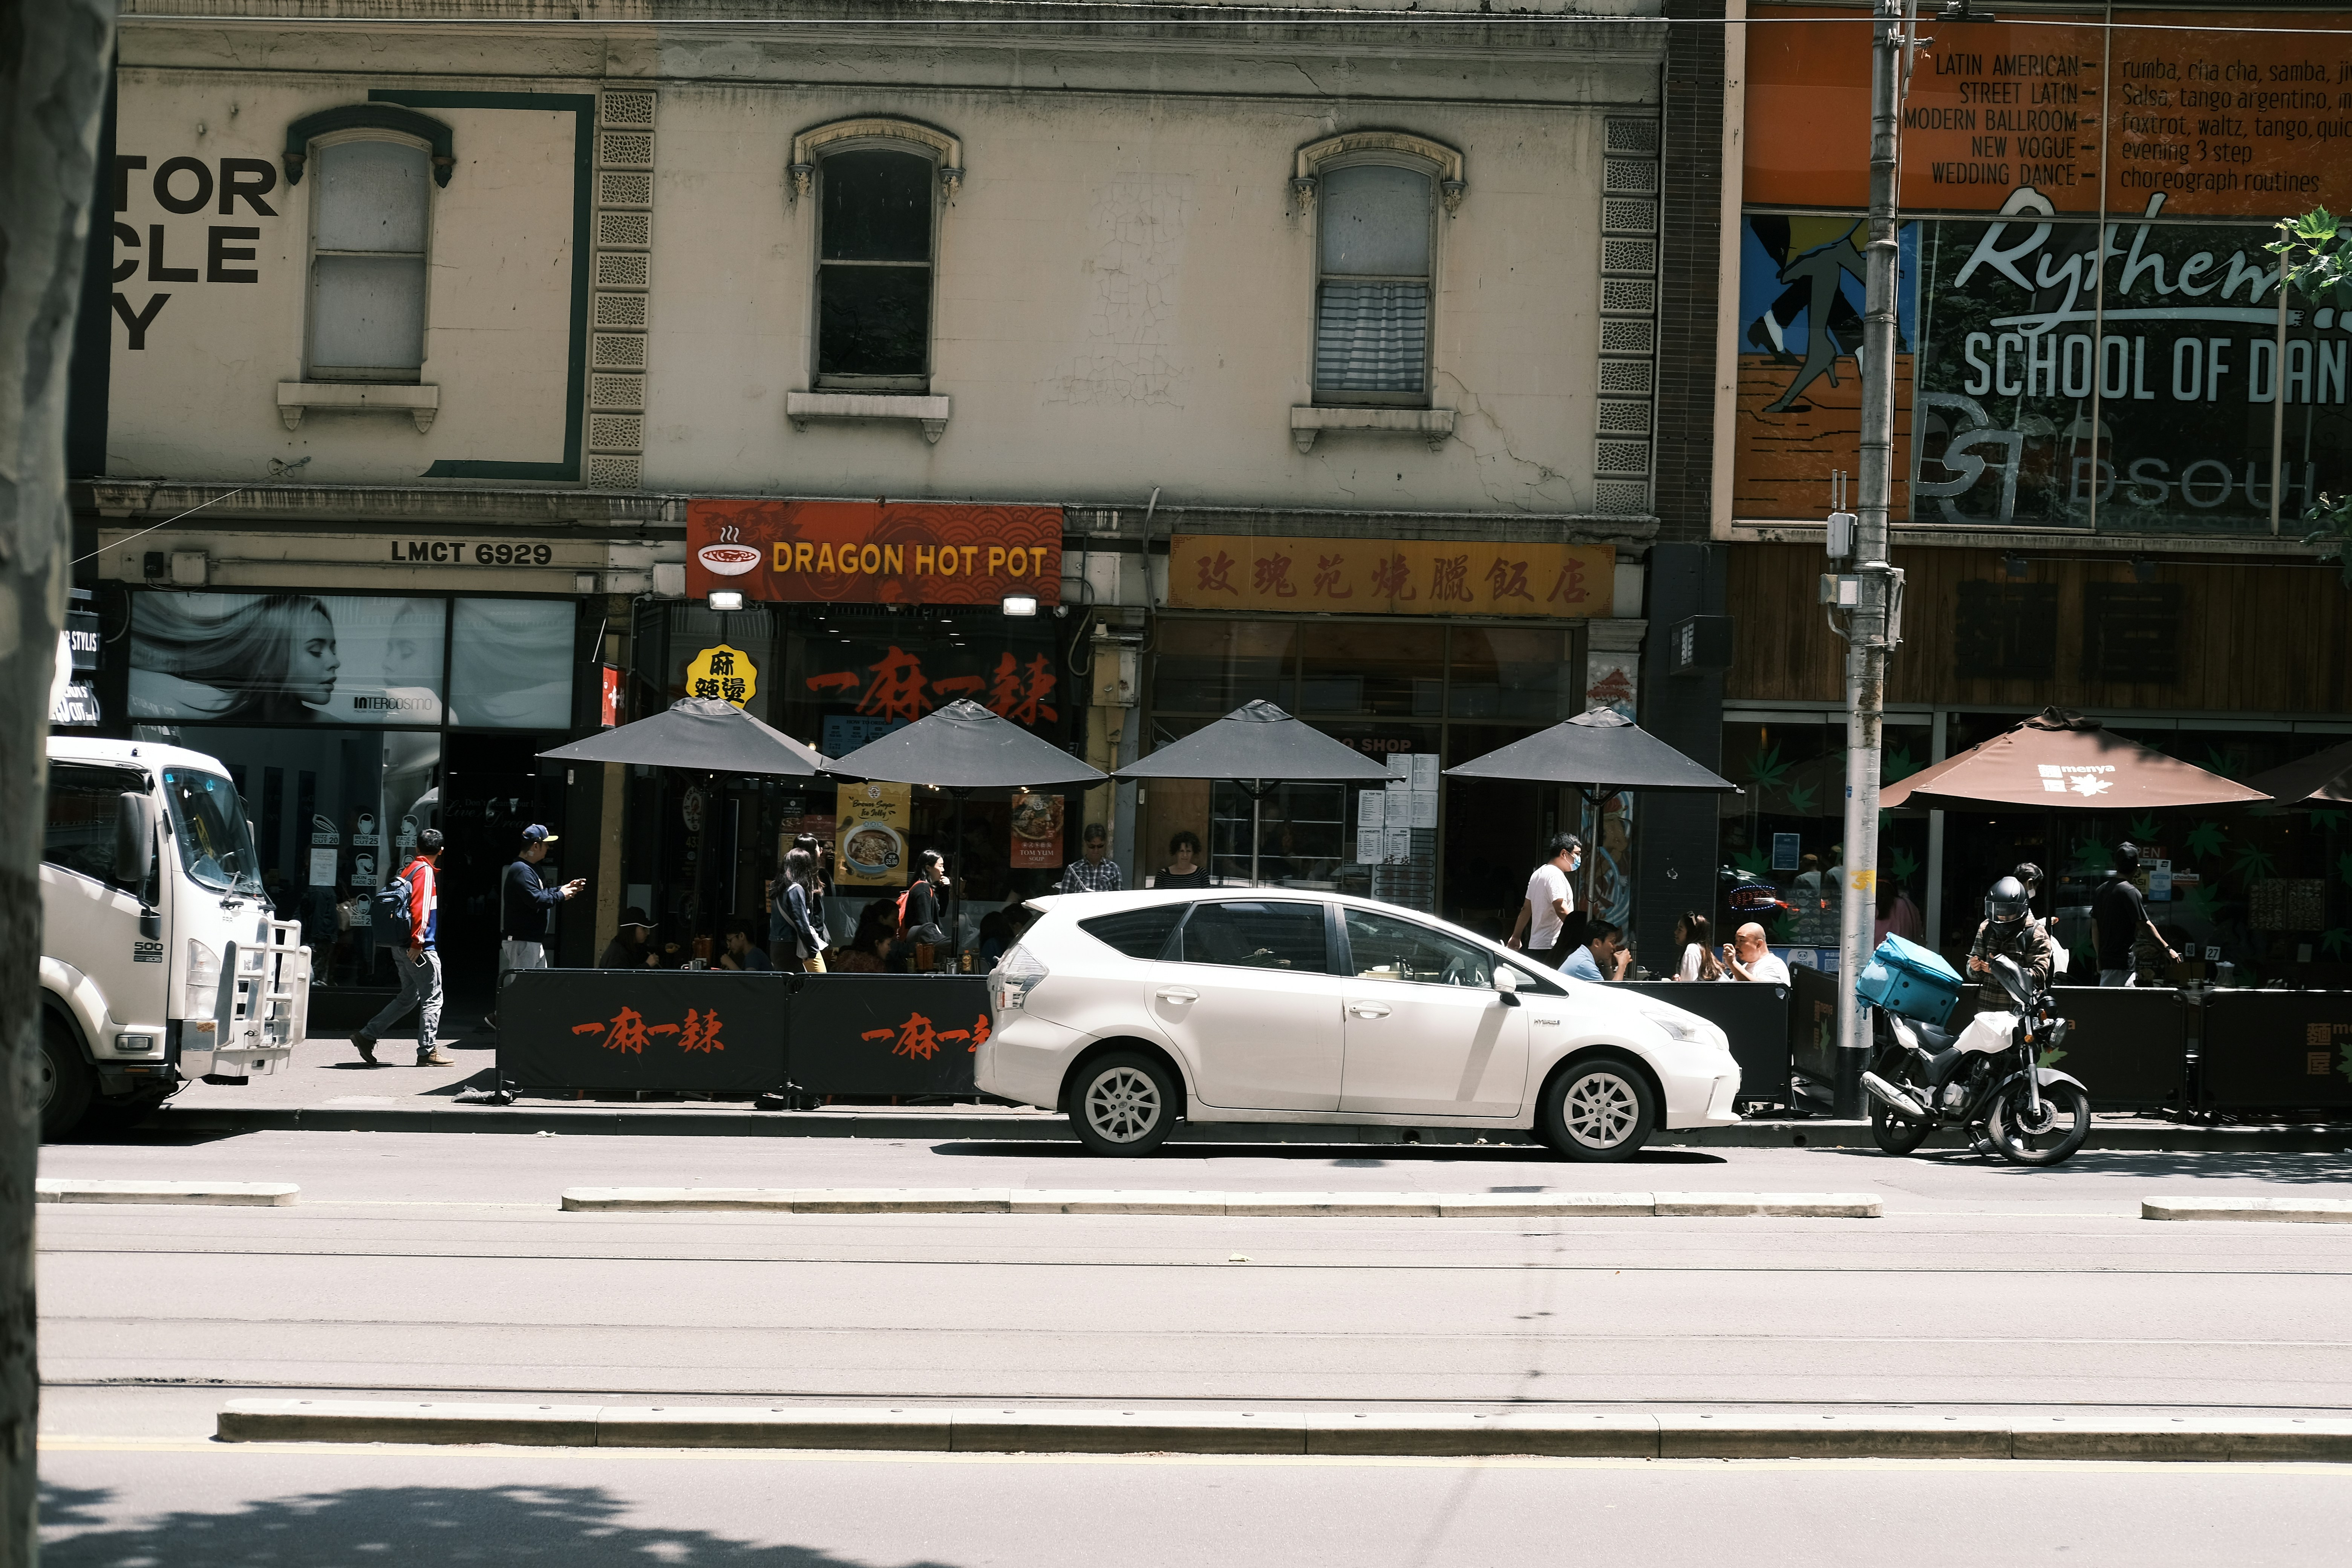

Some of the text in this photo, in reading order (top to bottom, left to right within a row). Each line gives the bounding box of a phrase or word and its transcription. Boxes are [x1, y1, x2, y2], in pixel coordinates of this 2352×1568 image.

[1936, 54, 1982, 75] LATIN
[2122, 58, 2182, 82] rumba,
[2188, 59, 2219, 81] cha
[2225, 60, 2262, 84] cha,
[2269, 60, 2331, 84] samba,
[1960, 82, 2022, 104] STREET
[2121, 83, 2173, 109] Salsa,
[2180, 88, 2231, 111] tango
[2237, 89, 2332, 112] argentino,
[1904, 107, 1975, 130] MODERN
[2121, 112, 2191, 138] foxtrot,
[2198, 115, 2248, 139] waltz,
[2254, 116, 2313, 141] tango,
[1972, 136, 2007, 158] NEW
[2121, 139, 2252, 166] evening 3 step
[1932, 162, 2009, 185] WEDDING
[2121, 166, 2319, 195] choreograph routines
[114, 155, 279, 216] TOR
[1963, 331, 2352, 405] SCHOOL OF DAN
[391, 541, 552, 565] LMCT 6929
[773, 541, 1048, 578] DRAGON HOT POT
[709, 651, 735, 676] 麻
[806, 645, 1059, 725] 一麻一辣
[1361, 738, 1412, 752] SHOP
[2061, 765, 2115, 774] menya
[861, 808, 886, 819] Ice Jelly
[876, 800, 896, 810] Sugar
[2138, 847, 2161, 859] PEN
[134, 942, 164, 951] 500
[2208, 948, 2219, 958] 27
[571, 1006, 724, 1054] 一麻一辣
